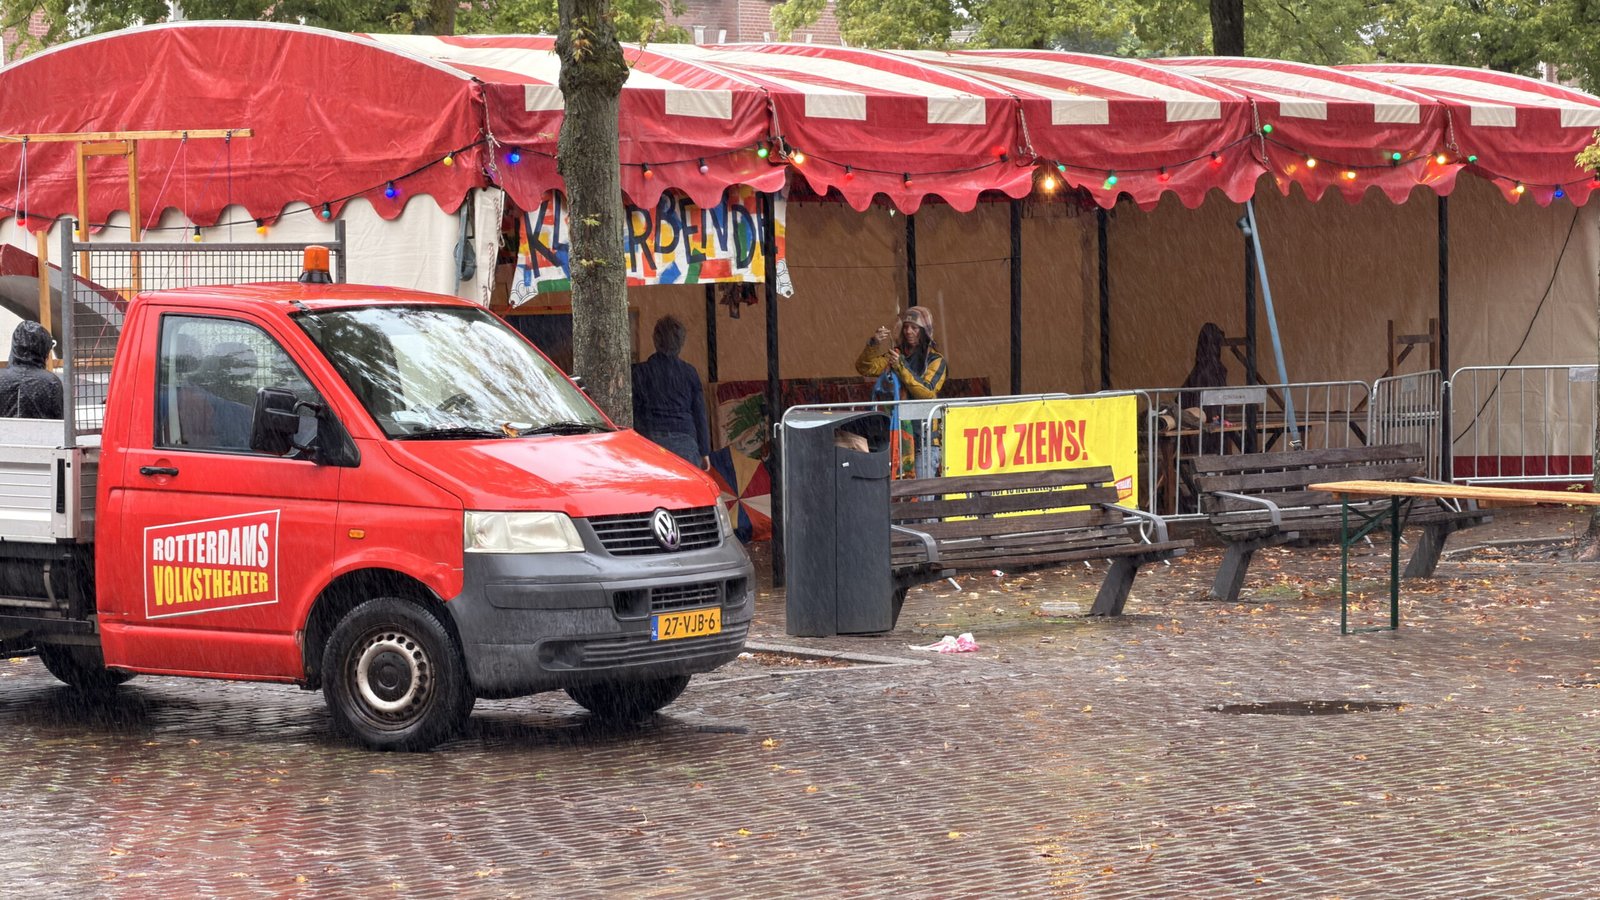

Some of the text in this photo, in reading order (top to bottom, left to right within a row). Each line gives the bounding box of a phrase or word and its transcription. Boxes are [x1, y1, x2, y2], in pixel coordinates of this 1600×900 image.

[963, 419, 1088, 470] TOT ZIENS!
[153, 522, 269, 568] ROTTERDAMS
[153, 565, 269, 606] VOLKSTHEATER
[664, 612, 715, 635] 27-VJB-6
